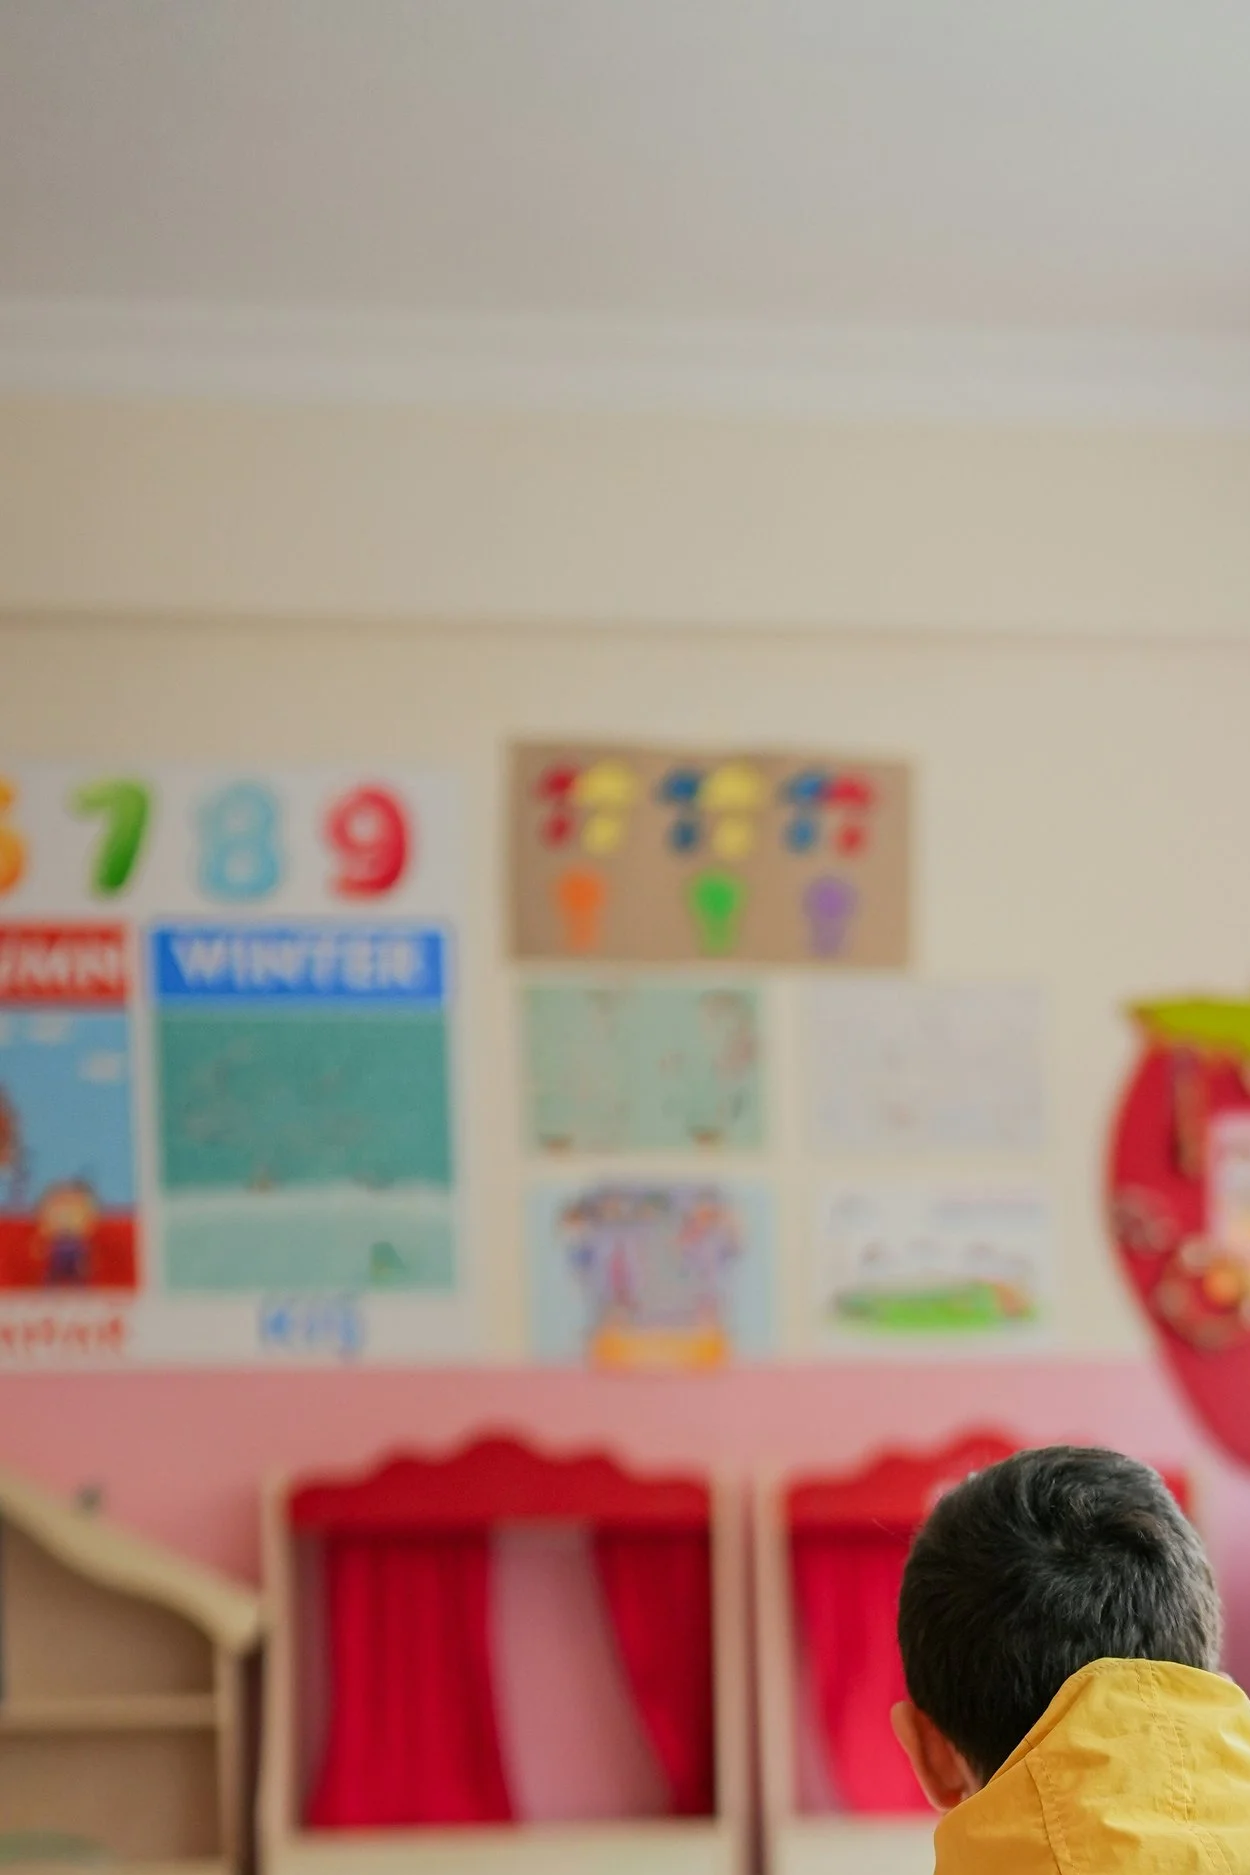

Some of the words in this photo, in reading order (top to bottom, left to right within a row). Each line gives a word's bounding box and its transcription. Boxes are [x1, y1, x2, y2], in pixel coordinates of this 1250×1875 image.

[72, 779, 152, 897] 7
[199, 782, 281, 900] 8
[327, 783, 411, 901] 9
[171, 936, 422, 989] WINTER
